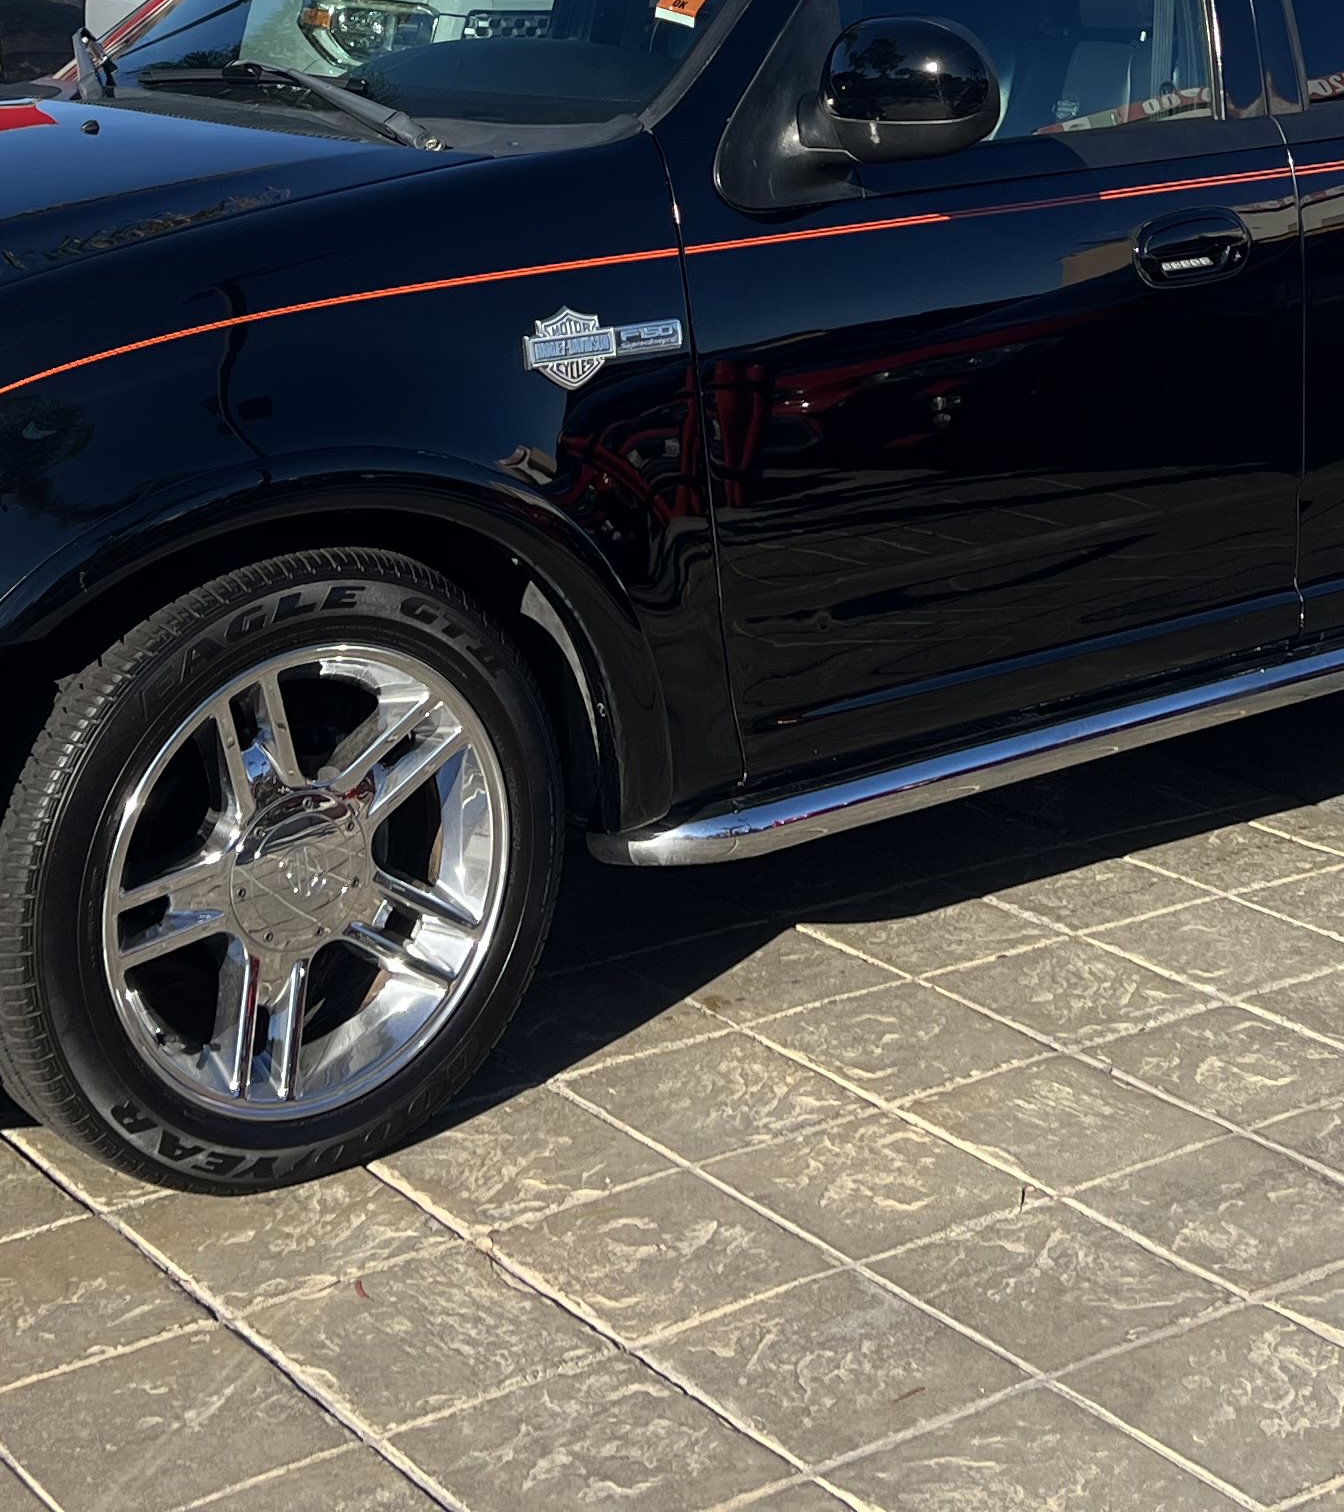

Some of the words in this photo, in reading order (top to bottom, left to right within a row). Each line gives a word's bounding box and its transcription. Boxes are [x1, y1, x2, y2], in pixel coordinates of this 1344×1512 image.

[672, 0, 688, 10] OK
[551, 317, 596, 337] MOTOR
[533, 332, 612, 362] HARLEY-DAVIDSON
[555, 358, 596, 380] CYCLES
